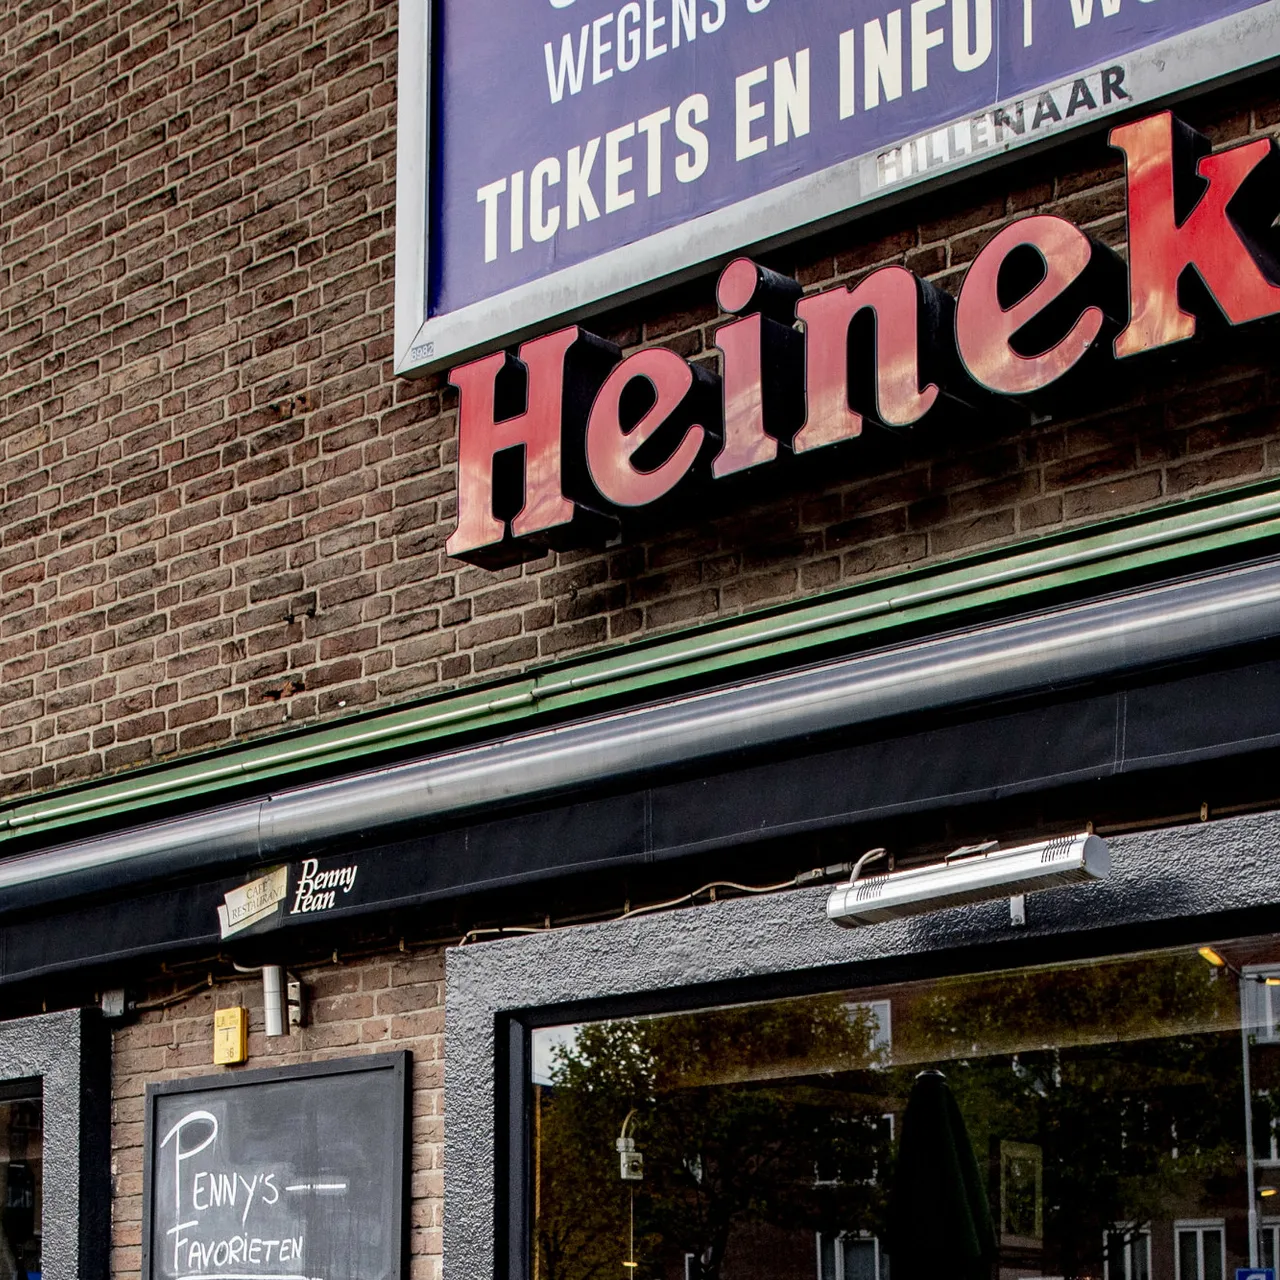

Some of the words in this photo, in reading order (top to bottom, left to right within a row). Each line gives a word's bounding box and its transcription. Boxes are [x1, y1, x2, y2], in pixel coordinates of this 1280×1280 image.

[544, 0, 726, 104] WEGENS
[477, 92, 709, 263] TICKETS
[735, 47, 810, 162] EN
[298, 857, 358, 893] Penny
[231, 884, 285, 920] RESTAURANT
[289, 878, 336, 915] Pean
